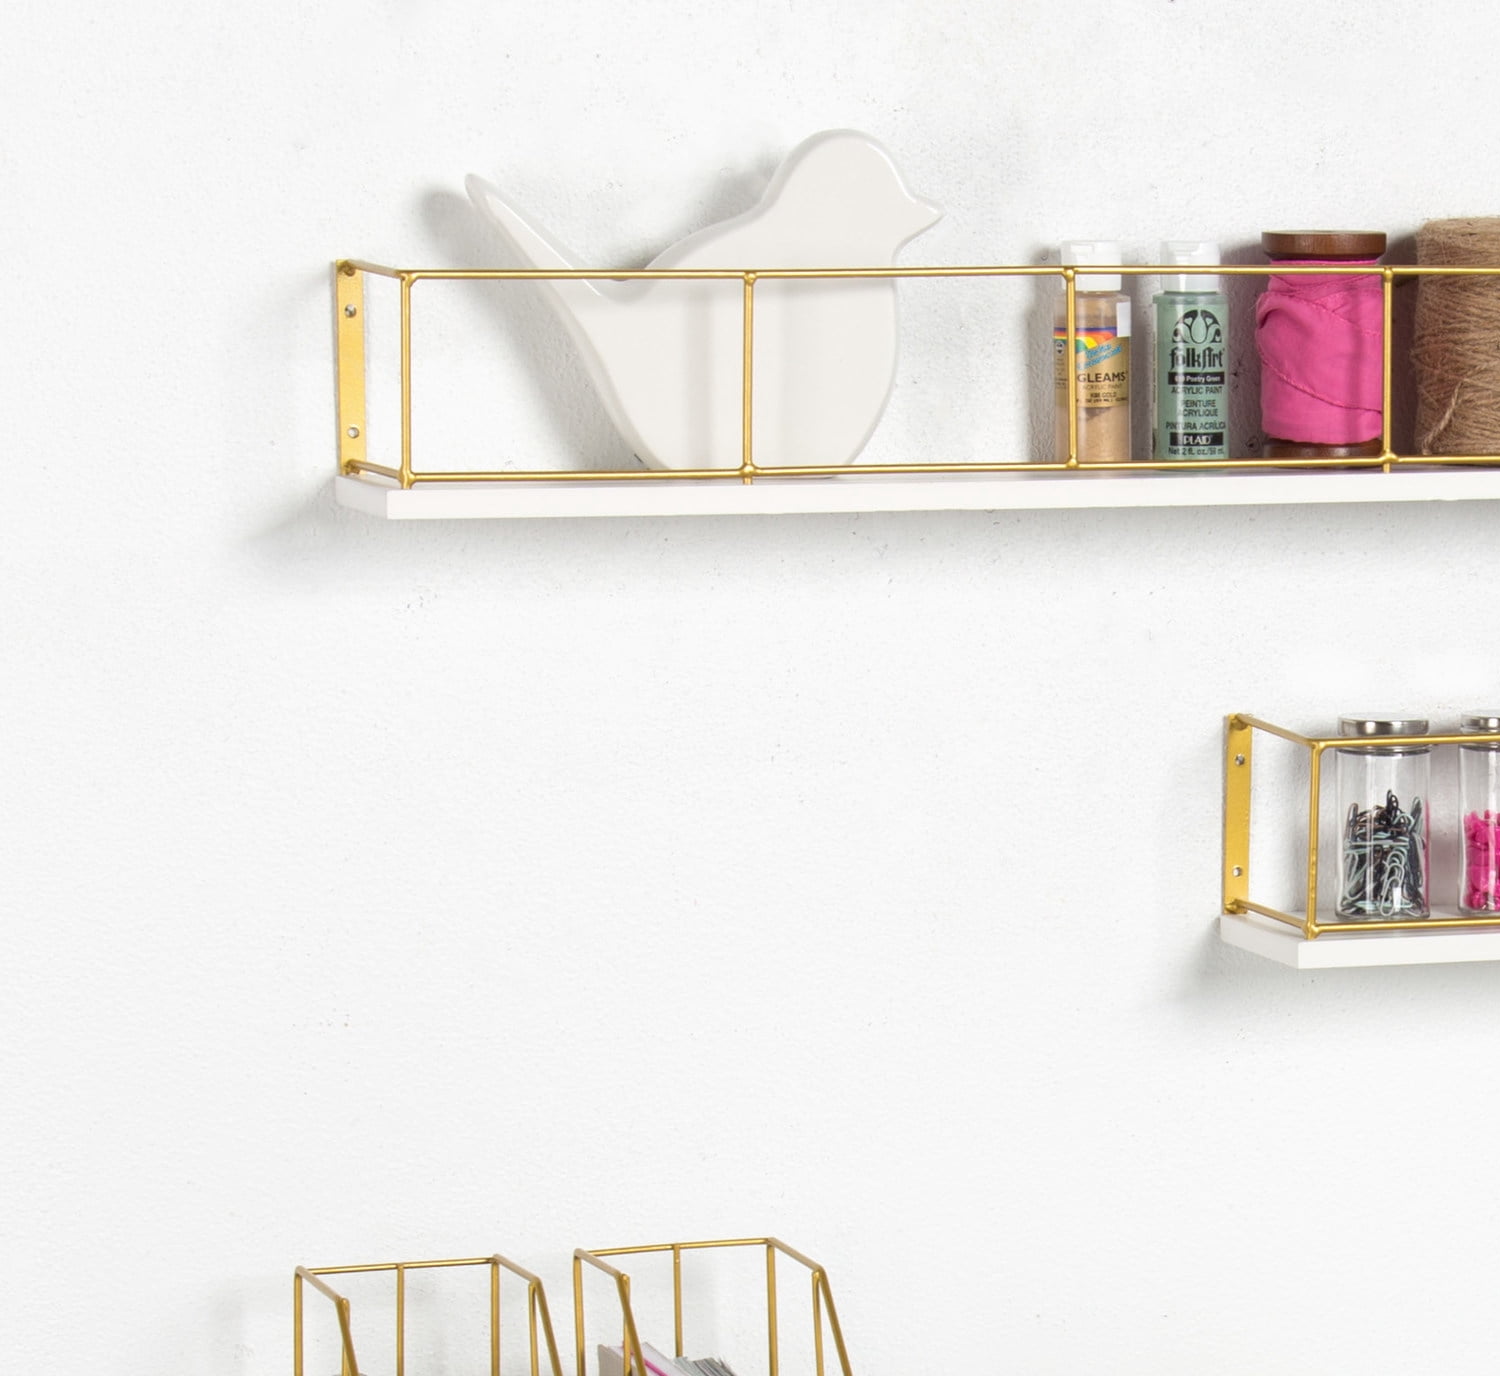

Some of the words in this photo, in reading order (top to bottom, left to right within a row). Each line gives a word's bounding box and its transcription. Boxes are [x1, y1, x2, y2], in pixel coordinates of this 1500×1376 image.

[1077, 371, 1127, 383] GLEAMS
[1178, 409, 1219, 417] CRYLIQUE
[1165, 421, 1198, 430] PINURA
[1183, 435, 1212, 445] PLAID
